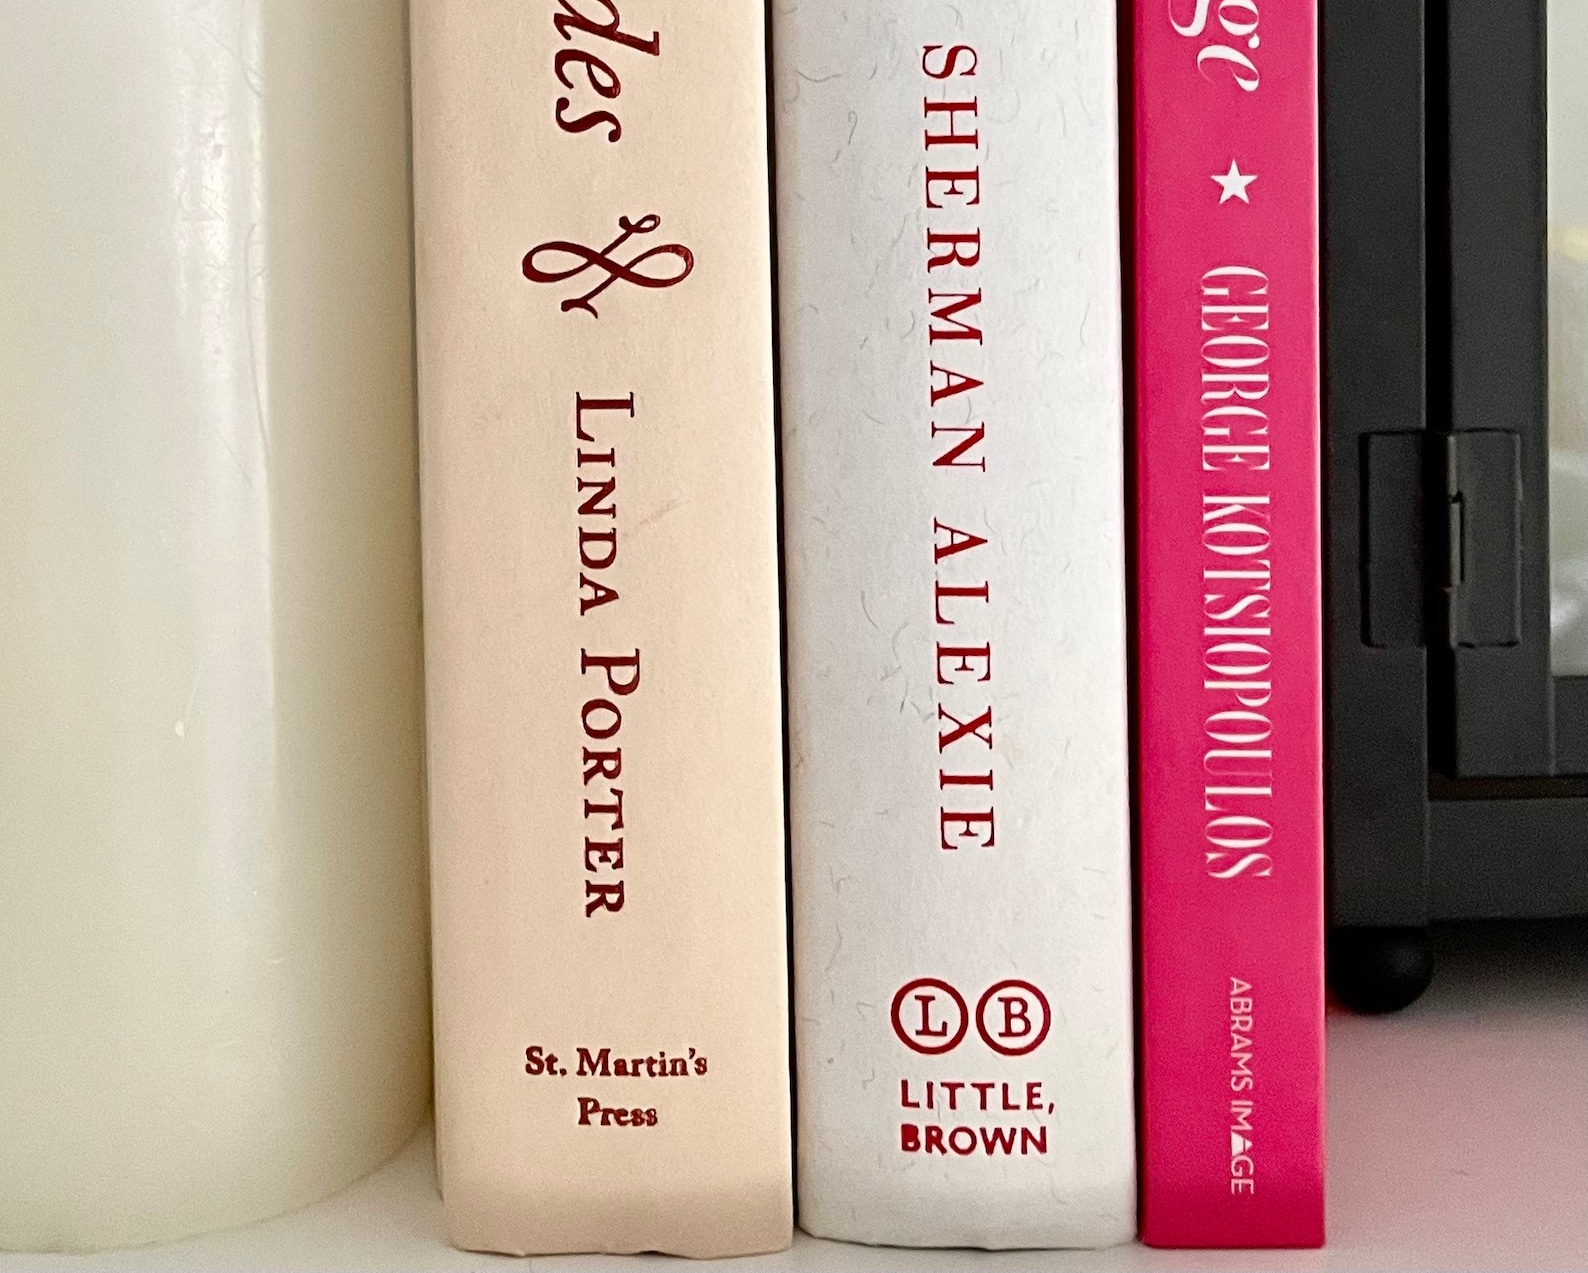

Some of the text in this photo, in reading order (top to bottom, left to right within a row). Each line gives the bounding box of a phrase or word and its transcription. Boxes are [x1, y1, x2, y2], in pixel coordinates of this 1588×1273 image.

[921, 43, 996, 852] SHERMAN ALEXIE
[1199, 265, 1273, 880] GEORGE KOTSIOPOULOS
[914, 994, 1033, 1039] L B
[525, 1045, 709, 1078] St. Martin's
[900, 1079, 1056, 1114] LITTLE,
[1229, 976, 1255, 1195] ABRAMS IMAGE
[578, 1097, 658, 1128] Press
[900, 1122, 1048, 1157] BROWN
